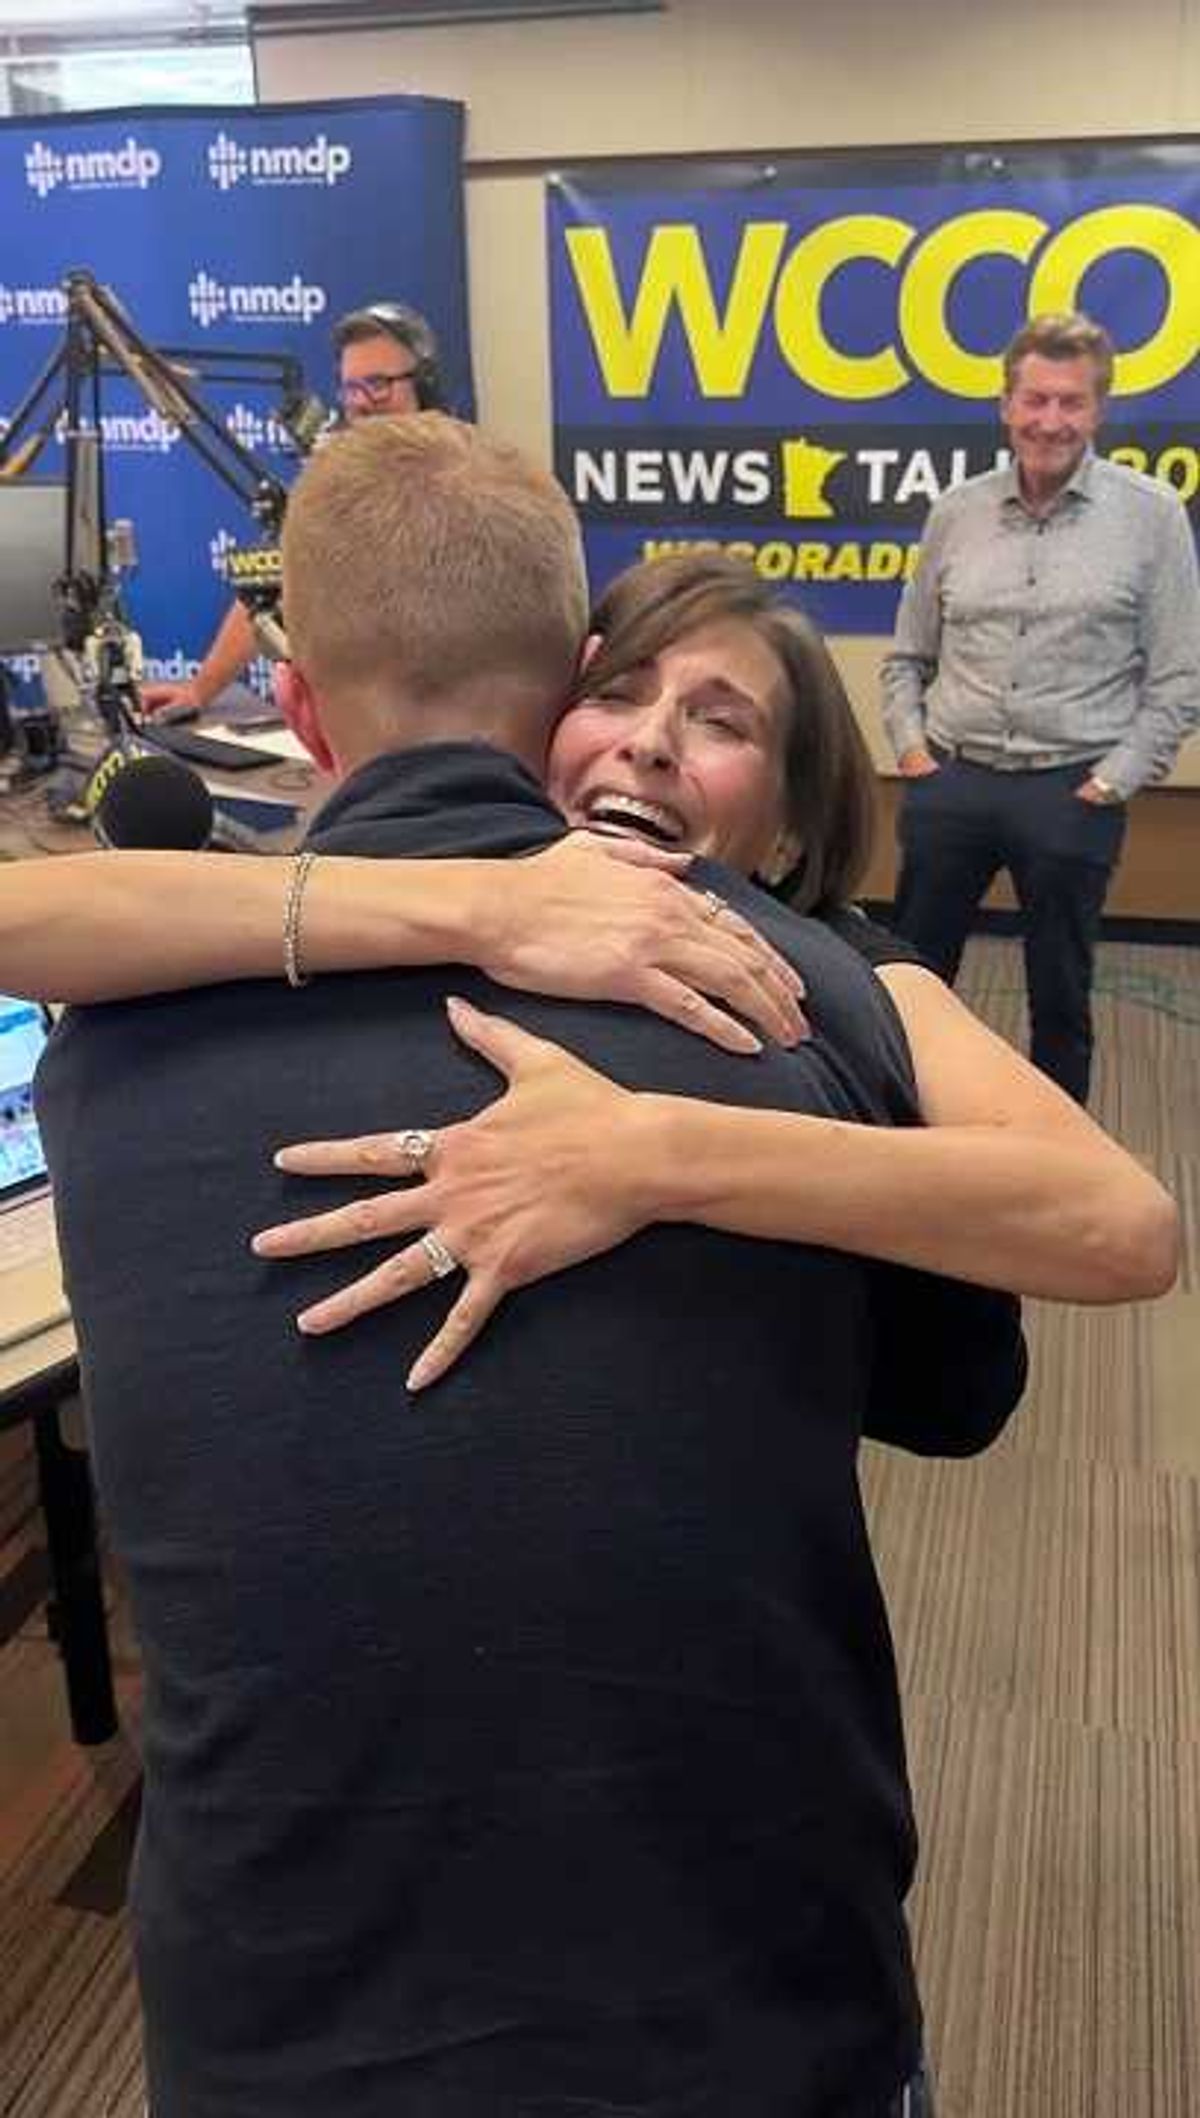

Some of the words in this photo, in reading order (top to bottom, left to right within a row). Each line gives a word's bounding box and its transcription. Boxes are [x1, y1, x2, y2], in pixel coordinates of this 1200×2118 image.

[65, 137, 161, 189] nmdp
[250, 135, 350, 185] nmdp
[15, 289, 69, 317] nm
[229, 274, 327, 323] nmdp
[563, 203, 1200, 401] WCCO
[574, 449, 771, 504] NEWS
